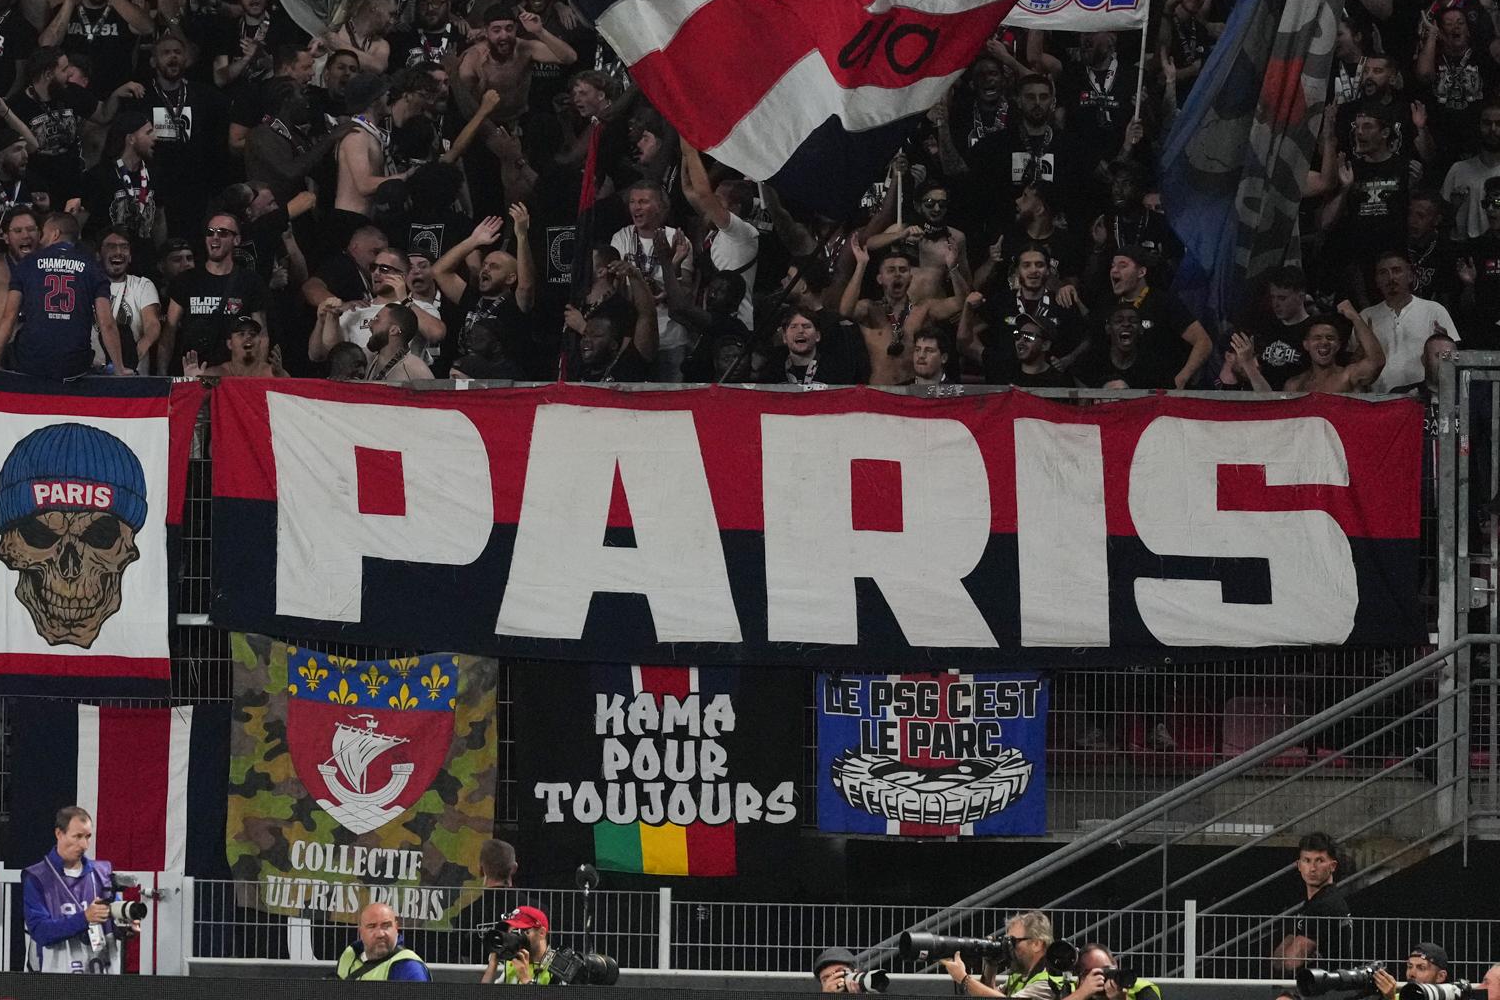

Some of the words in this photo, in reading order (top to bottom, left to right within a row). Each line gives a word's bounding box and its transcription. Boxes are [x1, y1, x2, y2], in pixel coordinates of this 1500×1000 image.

[37, 257, 86, 273] CHAMPIONS
[43, 274, 77, 313] 25
[31, 480, 114, 509] PARIS
[267, 391, 1360, 648] PARIS
[594, 692, 736, 737] KAMA
[824, 678, 862, 716] LE
[870, 679, 934, 718] PSG
[602, 737, 729, 782] POUR
[860, 718, 897, 757] LE
[906, 720, 1002, 760] PARC
[534, 780, 797, 825] TOUJOURS
[290, 838, 425, 881] COLLECTIF
[265, 874, 361, 914] ULTRAS
[368, 884, 446, 923] PARIS
